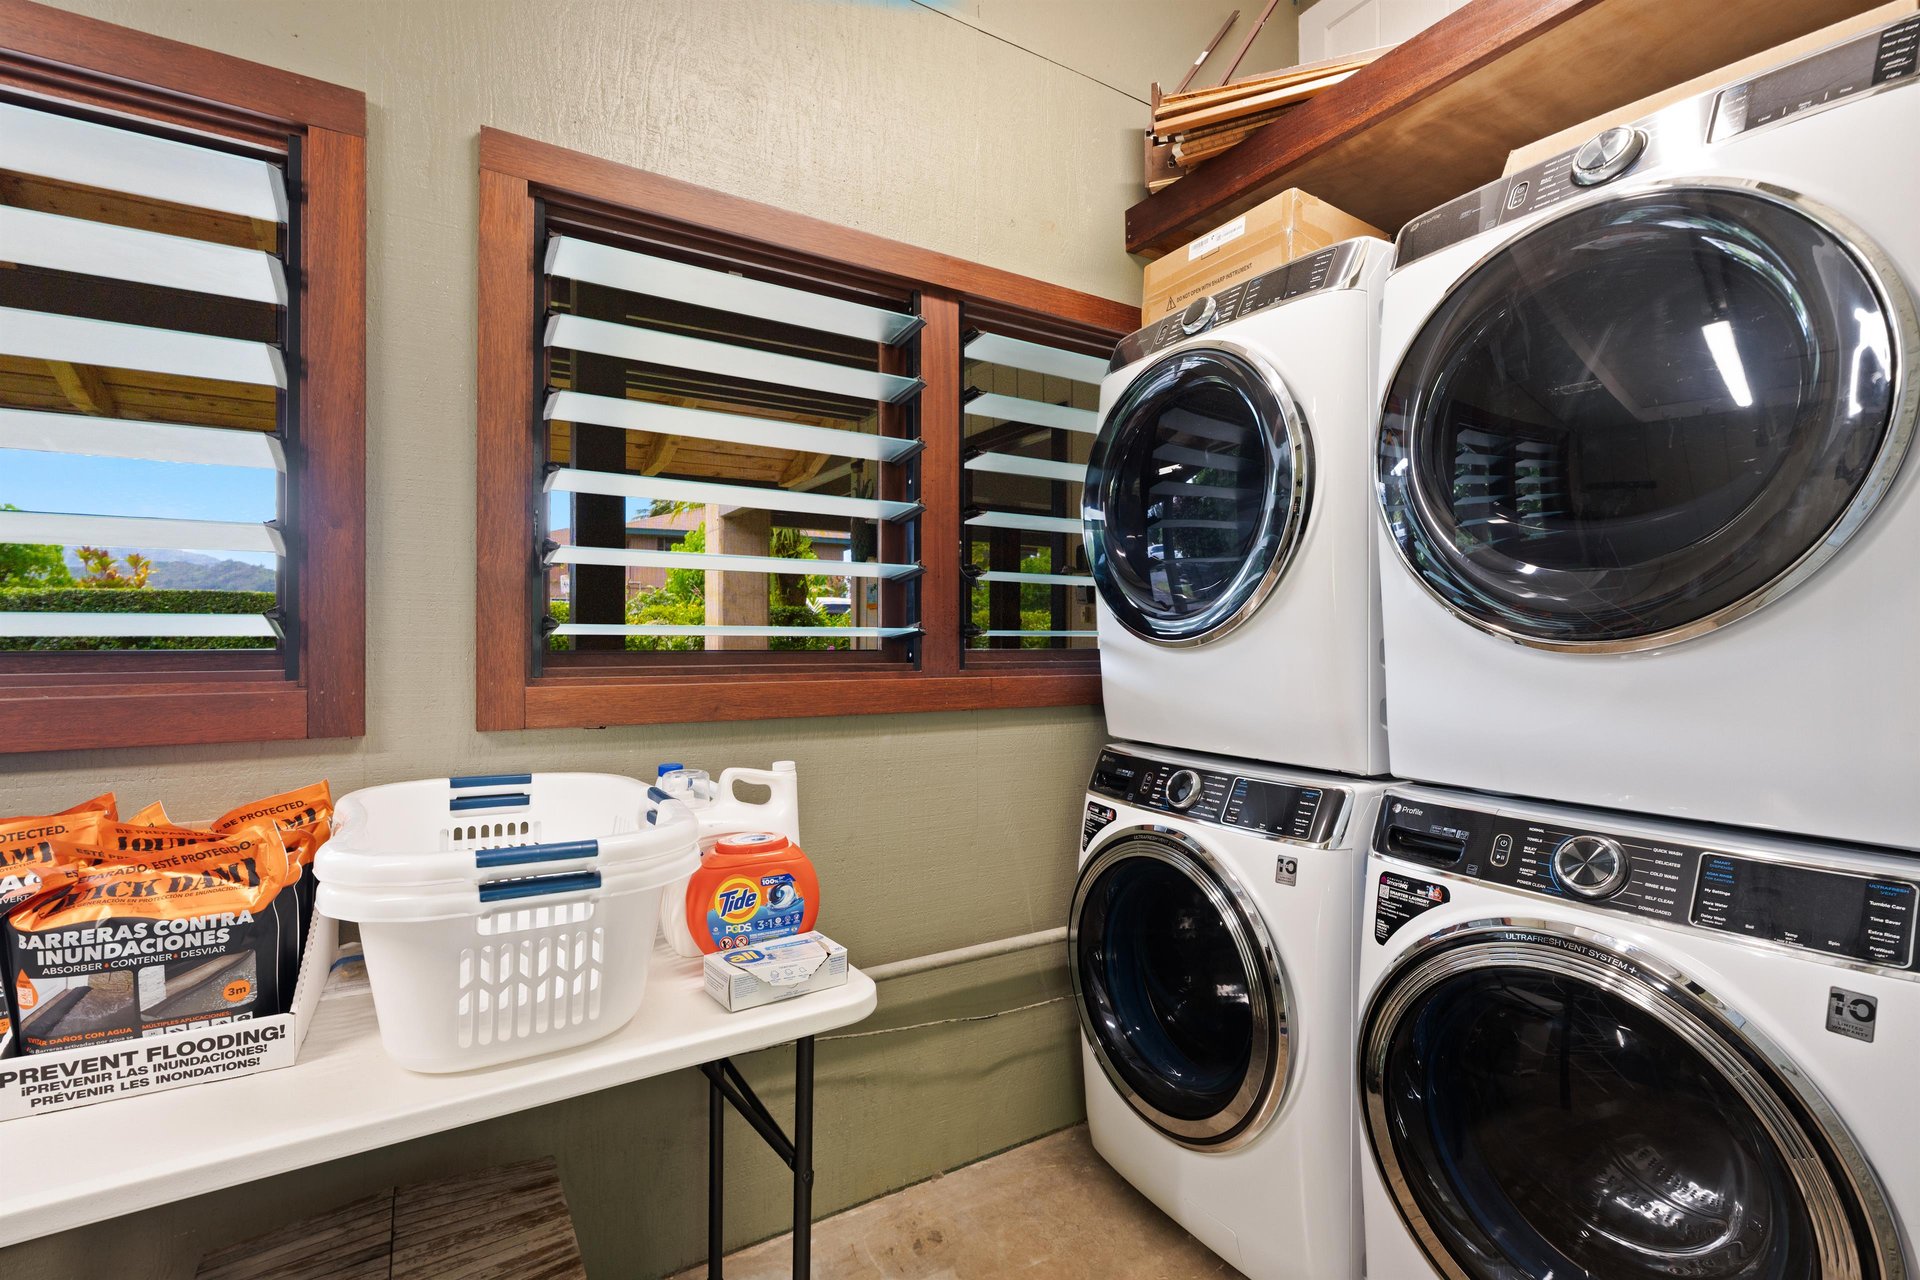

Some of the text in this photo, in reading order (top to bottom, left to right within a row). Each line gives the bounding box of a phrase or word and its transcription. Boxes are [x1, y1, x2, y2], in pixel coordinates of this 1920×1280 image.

[1183, 292, 1191, 300] NOT
[1190, 288, 1201, 296] OPEN
[1201, 283, 1212, 291] WITH
[1211, 275, 1226, 287] SHARP
[1225, 262, 1253, 280] INSTRUMENT
[222, 819, 238, 829] BE
[238, 800, 309, 823] PROTECTED.
[1402, 806, 1424, 816] Profile
[152, 855, 180, 870] ESTÉ
[180, 840, 256, 864] PROTEGIDO.
[762, 878, 779, 886] 100%
[1868, 883, 1910, 894] ULTRAFRESH
[718, 887, 758, 919] Tide
[1657, 897, 1674, 905] CLEAN
[1869, 900, 1891, 908] Tumble
[1637, 904, 1672, 917] DOWNLOADED
[18, 909, 255, 950] BARRERAS CONTRA
[725, 922, 752, 934] PODS
[37, 928, 231, 966] INUNDACIONES
[1506, 932, 1562, 947] ULTRAFRESH
[1562, 939, 1588, 954] VENT
[1587, 949, 1628, 971] SYSTEM
[1869, 946, 1895, 955] PreWash
[42, 945, 227, 976] ABSORBER CONTENER DESVIAR
[729, 949, 760, 965] all
[227, 986, 247, 997] 3m
[179, 1010, 232, 1024] APLICACIONES:
[49, 1032, 83, 1045] DAÑOS
[85, 1030, 105, 1041] CON
[107, 1027, 134, 1038] AGUA
[63, 1041, 96, 1050] activadas
[0, 1024, 286, 1089] PREVENT FLOODING!
[116, 1065, 149, 1080] LAS
[153, 1043, 268, 1073] INUNDACIONES!
[30, 1057, 261, 1108] PRÉVENIR LES INONDATIONS!
